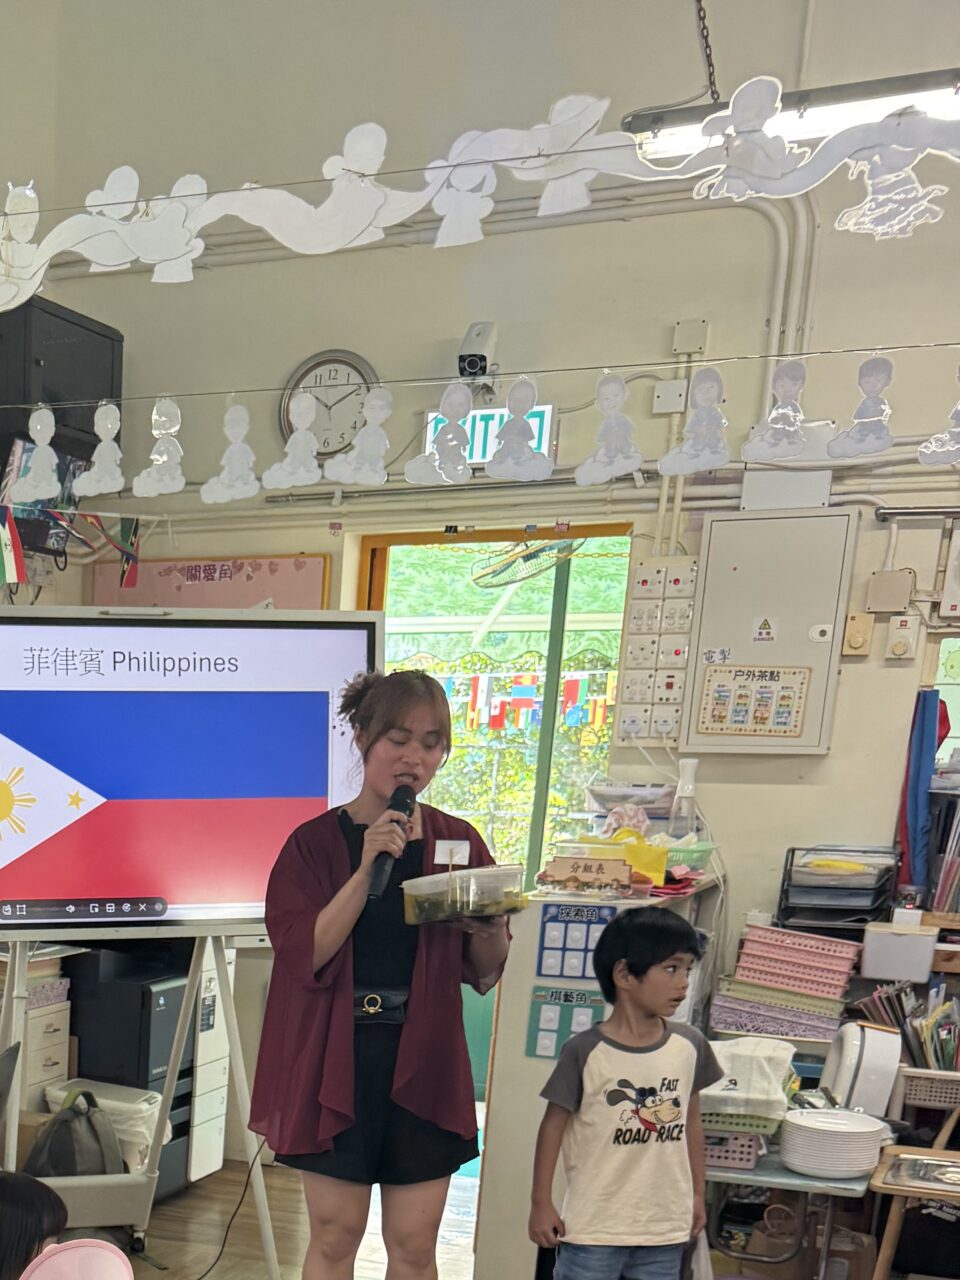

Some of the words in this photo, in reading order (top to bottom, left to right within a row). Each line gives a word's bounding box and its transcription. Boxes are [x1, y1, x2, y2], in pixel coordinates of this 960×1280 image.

[328, 368, 339, 381] 12
[322, 437, 330, 448] 6
[23, 646, 105, 677] 菲律賓
[112, 651, 239, 677] Philippines
[570, 862, 606, 875] 分組表
[659, 1077, 680, 1092] FAST
[612, 1127, 652, 1145] ROAD
[655, 1123, 685, 1143] RACE
